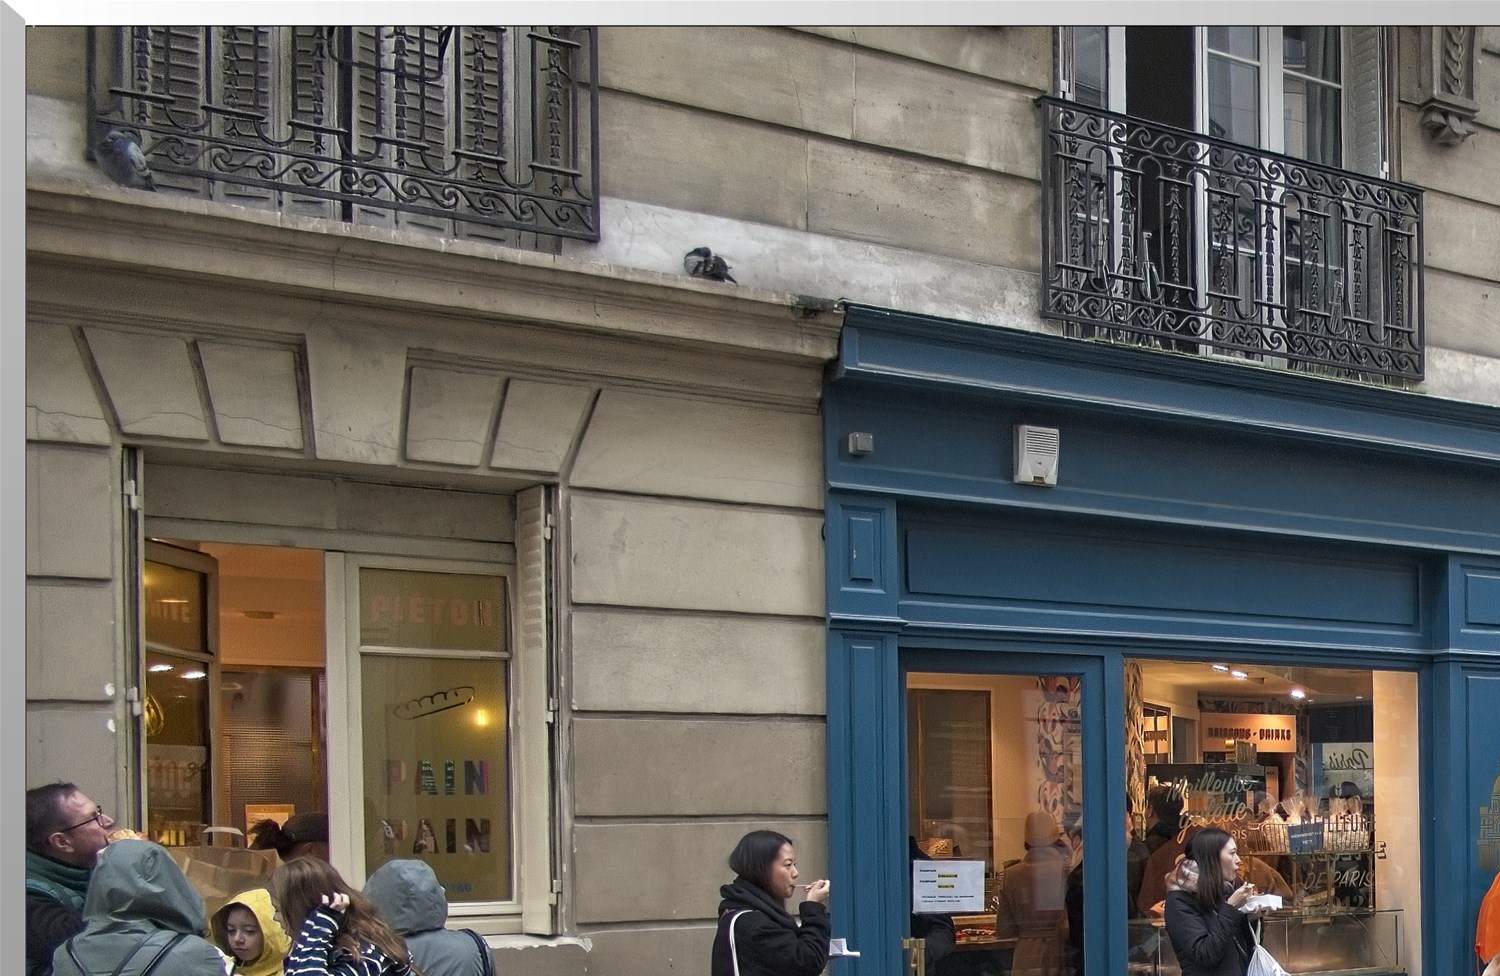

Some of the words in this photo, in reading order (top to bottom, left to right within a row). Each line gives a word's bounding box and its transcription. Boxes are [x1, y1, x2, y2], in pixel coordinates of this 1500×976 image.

[1207, 727, 1252, 740] BOISSONS
[1259, 728, 1292, 741] DRINKS
[384, 759, 489, 796] PAIN
[1166, 771, 1253, 803] Meilleure
[382, 818, 490, 854] PAIN
[1177, 796, 1248, 844] galette
[1303, 873, 1327, 890] DE
[1334, 870, 1374, 888] PARIS
